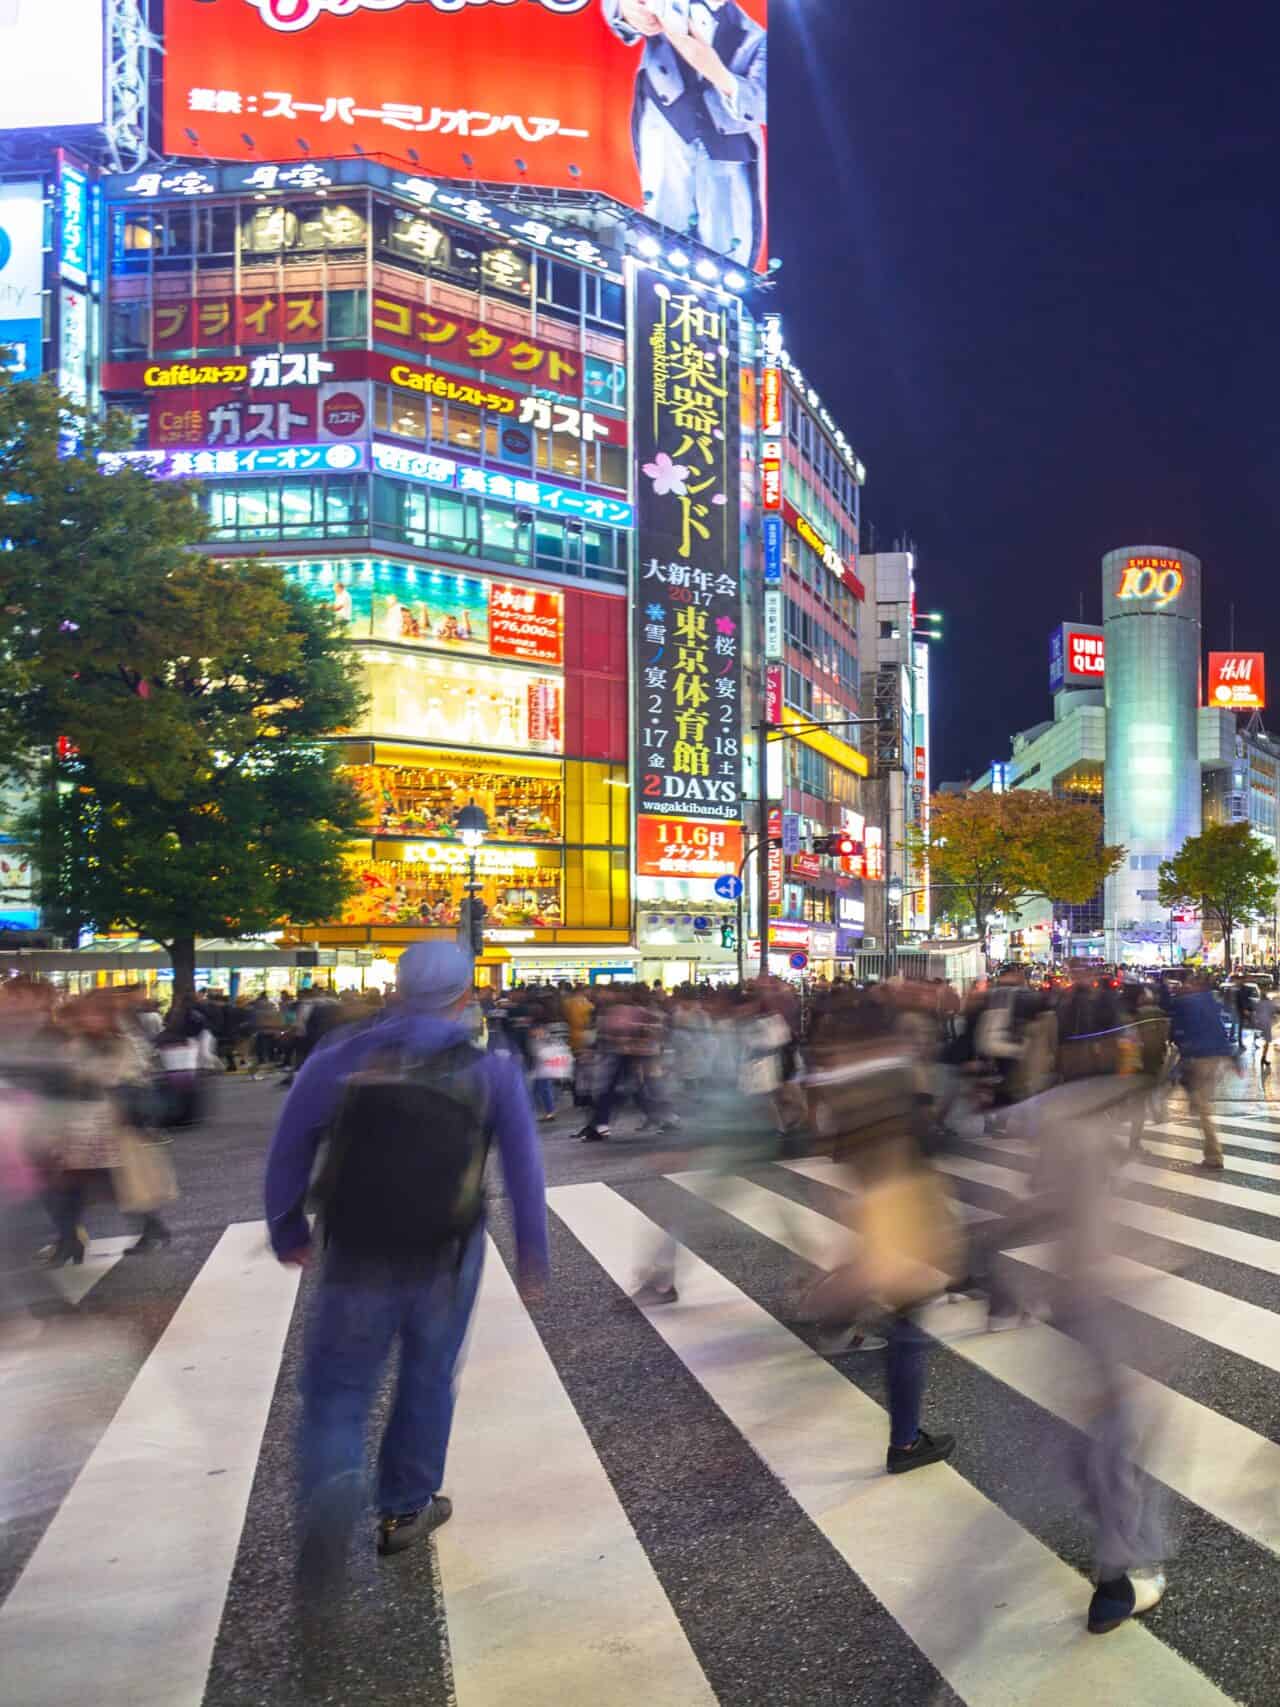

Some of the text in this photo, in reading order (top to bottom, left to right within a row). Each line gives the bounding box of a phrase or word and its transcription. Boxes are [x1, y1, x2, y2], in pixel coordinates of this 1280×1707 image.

[156, 297, 318, 339] プライス
[374, 299, 576, 381] コンタクト
[250, 352, 335, 387] ガスト
[208, 402, 309, 444] ガスト
[518, 396, 609, 441] ガスト
[669, 294, 728, 558] 和楽器バンド
[642, 558, 737, 597] 大新年会
[1129, 559, 1182, 569] SHIBUYA
[669, 587, 713, 607] 2017
[1116, 567, 1183, 608] 109
[1073, 638, 1103, 655] UNI
[1219, 658, 1254, 681] H&M
[672, 606, 710, 776] 東京体育館
[643, 774, 736, 803] 2DAYS
[643, 800, 738, 818] wagakkiband.jp
[664, 845, 720, 861] チケット
